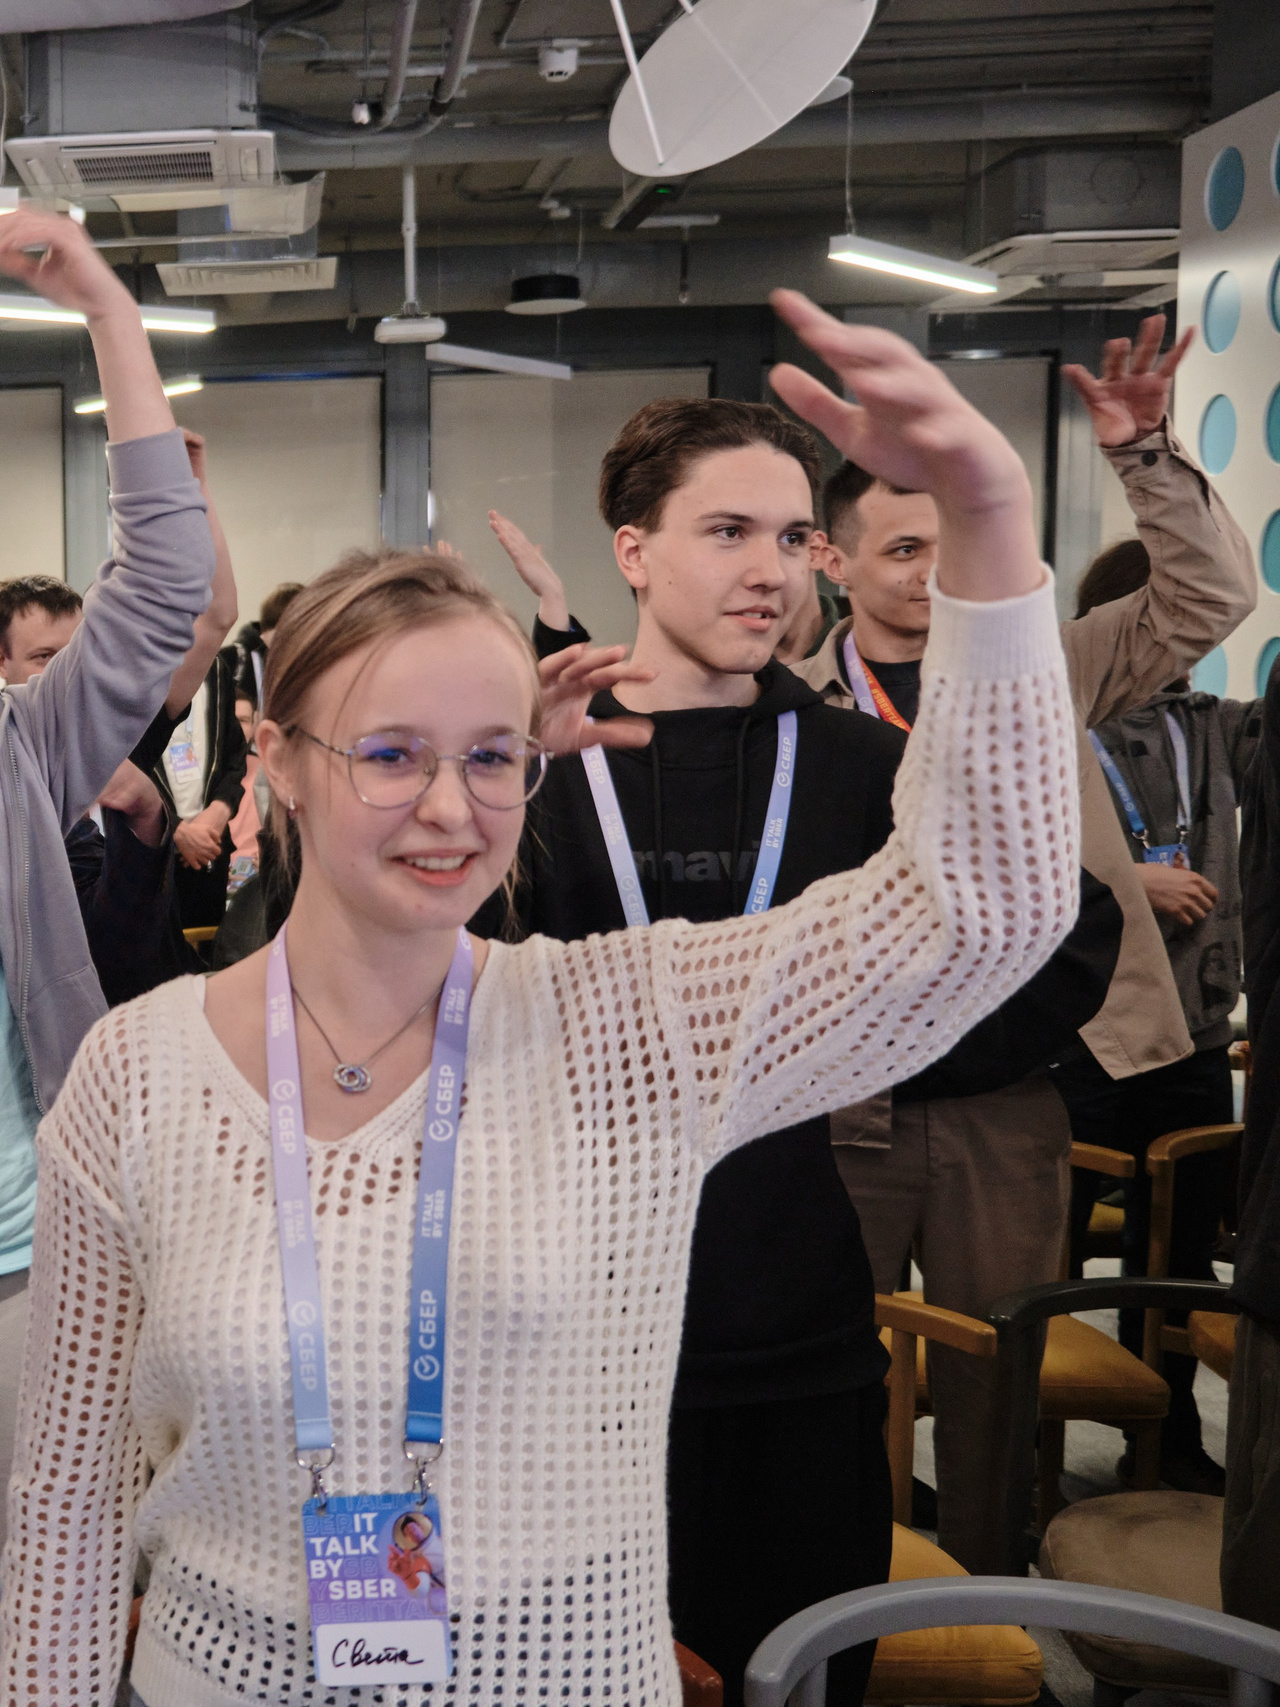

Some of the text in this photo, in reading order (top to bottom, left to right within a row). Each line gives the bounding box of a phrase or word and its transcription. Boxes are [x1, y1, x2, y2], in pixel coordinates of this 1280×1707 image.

[587, 752, 606, 785] СБЕР
[781, 736, 793, 770] СБЕР
[751, 877, 769, 914] СБЕР
[435, 1064, 455, 1115] СБЕР
[277, 1105, 297, 1155] СБЕР
[421, 1193, 435, 1238] IT TALK
[419, 1289, 437, 1350] СБЕР
[297, 1332, 318, 1391] СБЕР
[353, 1512, 378, 1533] IT
[309, 1534, 380, 1557] TALK
[309, 1558, 344, 1579] BY
[328, 1578, 398, 1601] SBER
[332, 1638, 424, 1668] Света
